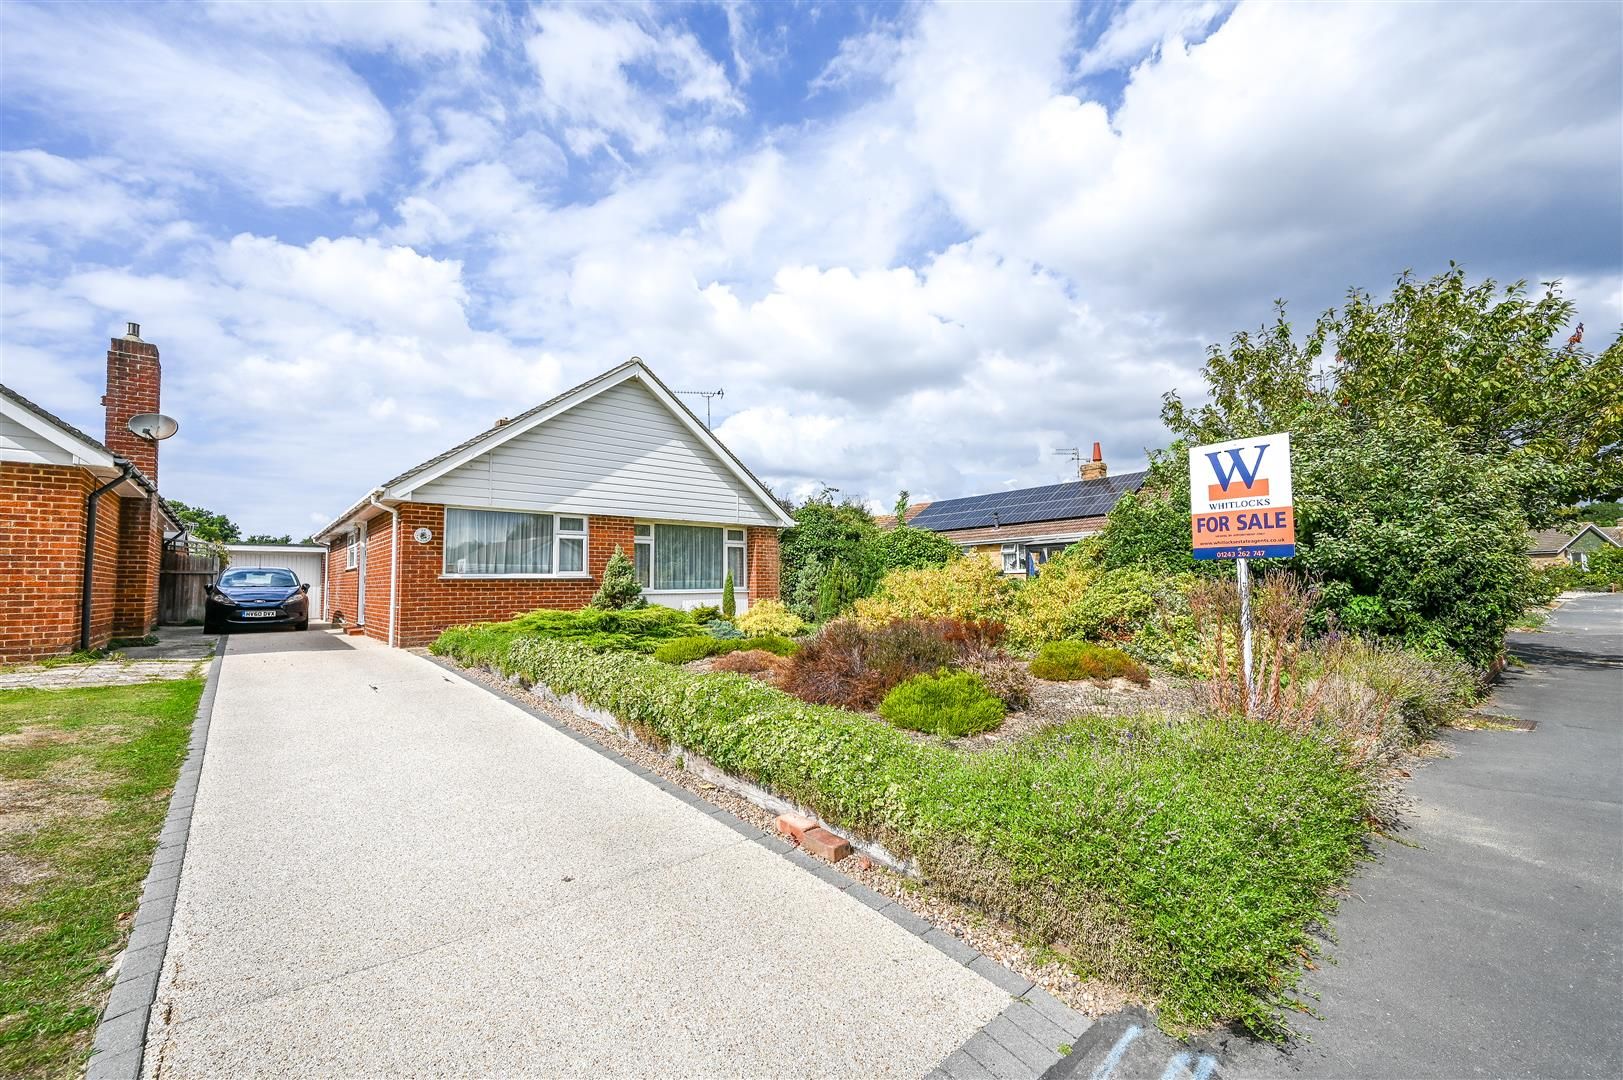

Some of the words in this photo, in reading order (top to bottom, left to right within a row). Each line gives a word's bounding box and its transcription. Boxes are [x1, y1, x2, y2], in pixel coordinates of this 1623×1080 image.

[1205, 444, 1270, 492] W
[1209, 498, 1271, 510] WHITLOCKS
[1197, 515, 1230, 533] FOR
[1237, 511, 1287, 531] SALE
